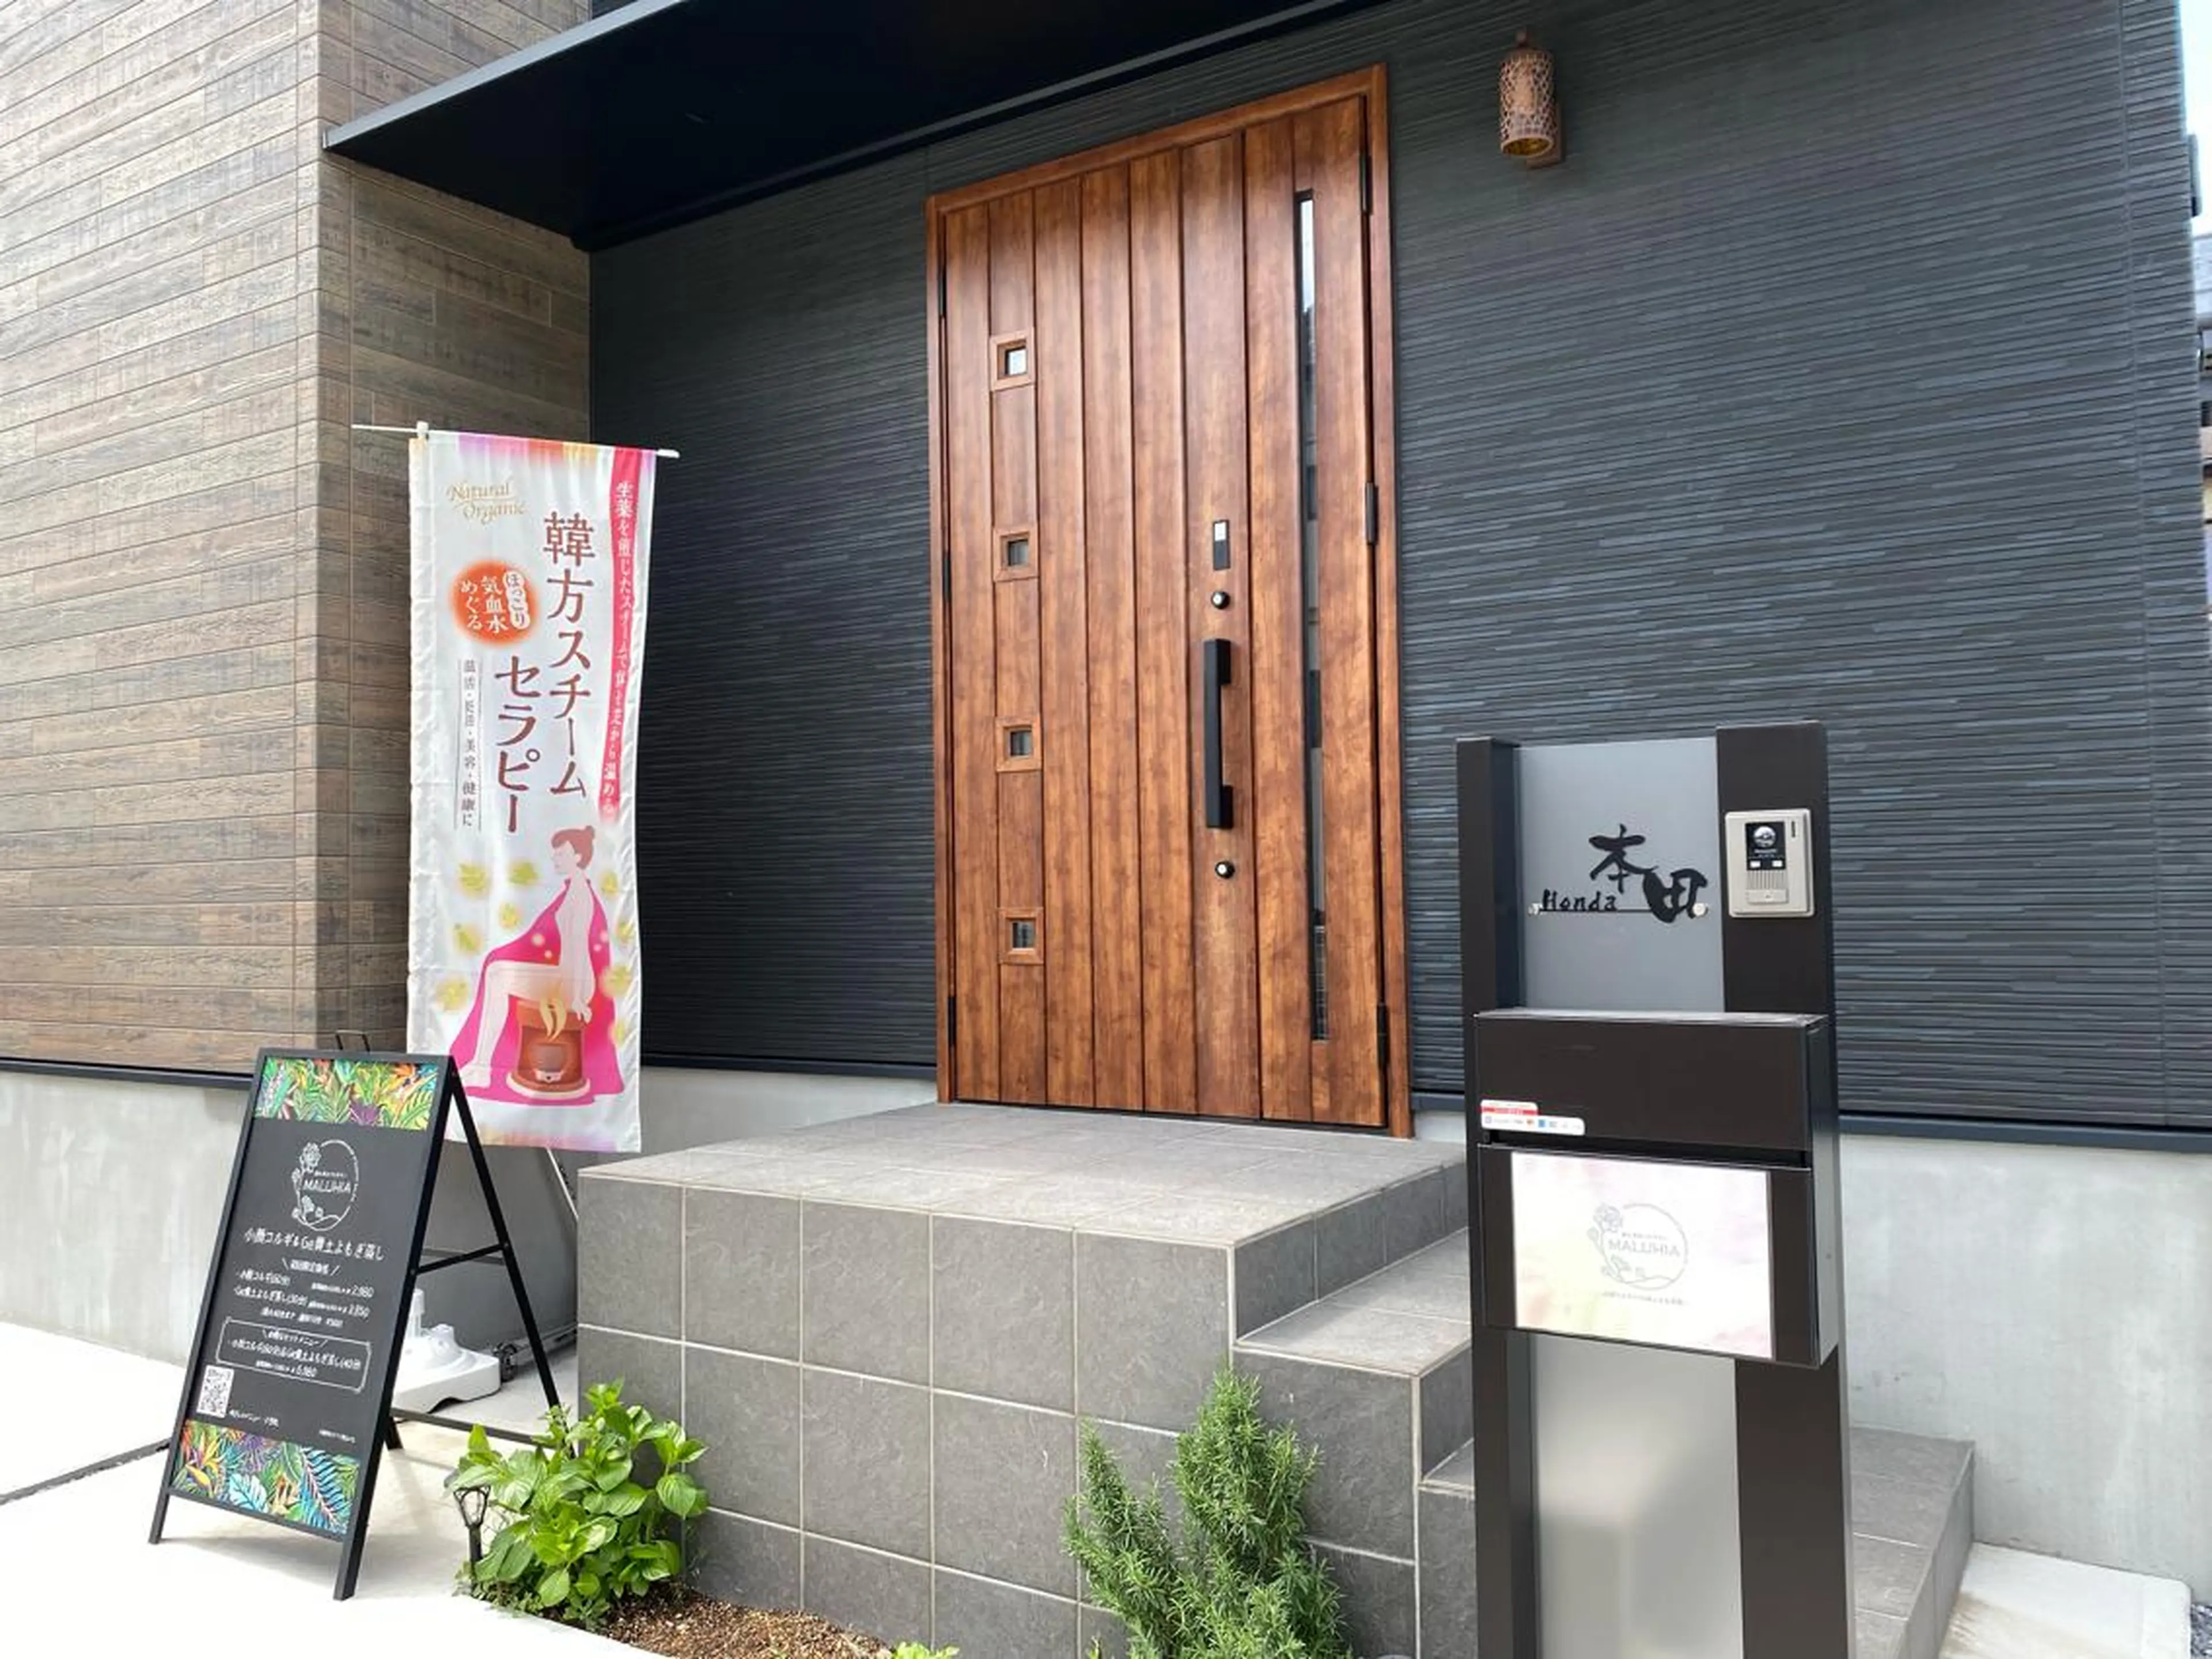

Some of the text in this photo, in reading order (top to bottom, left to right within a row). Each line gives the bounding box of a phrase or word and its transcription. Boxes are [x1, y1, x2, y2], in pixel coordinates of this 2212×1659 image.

[447, 478, 515, 502] Natural
[463, 500, 527, 525] Organic
[460, 580, 483, 631] めぐる
[480, 575, 509, 633] 気血水
[505, 572, 529, 629] ほっこり
[543, 512, 596, 798] 韓方スチーム
[494, 656, 541, 833] セラピー
[1542, 888, 1618, 911] Honda
[1588, 823, 1709, 923] 本田
